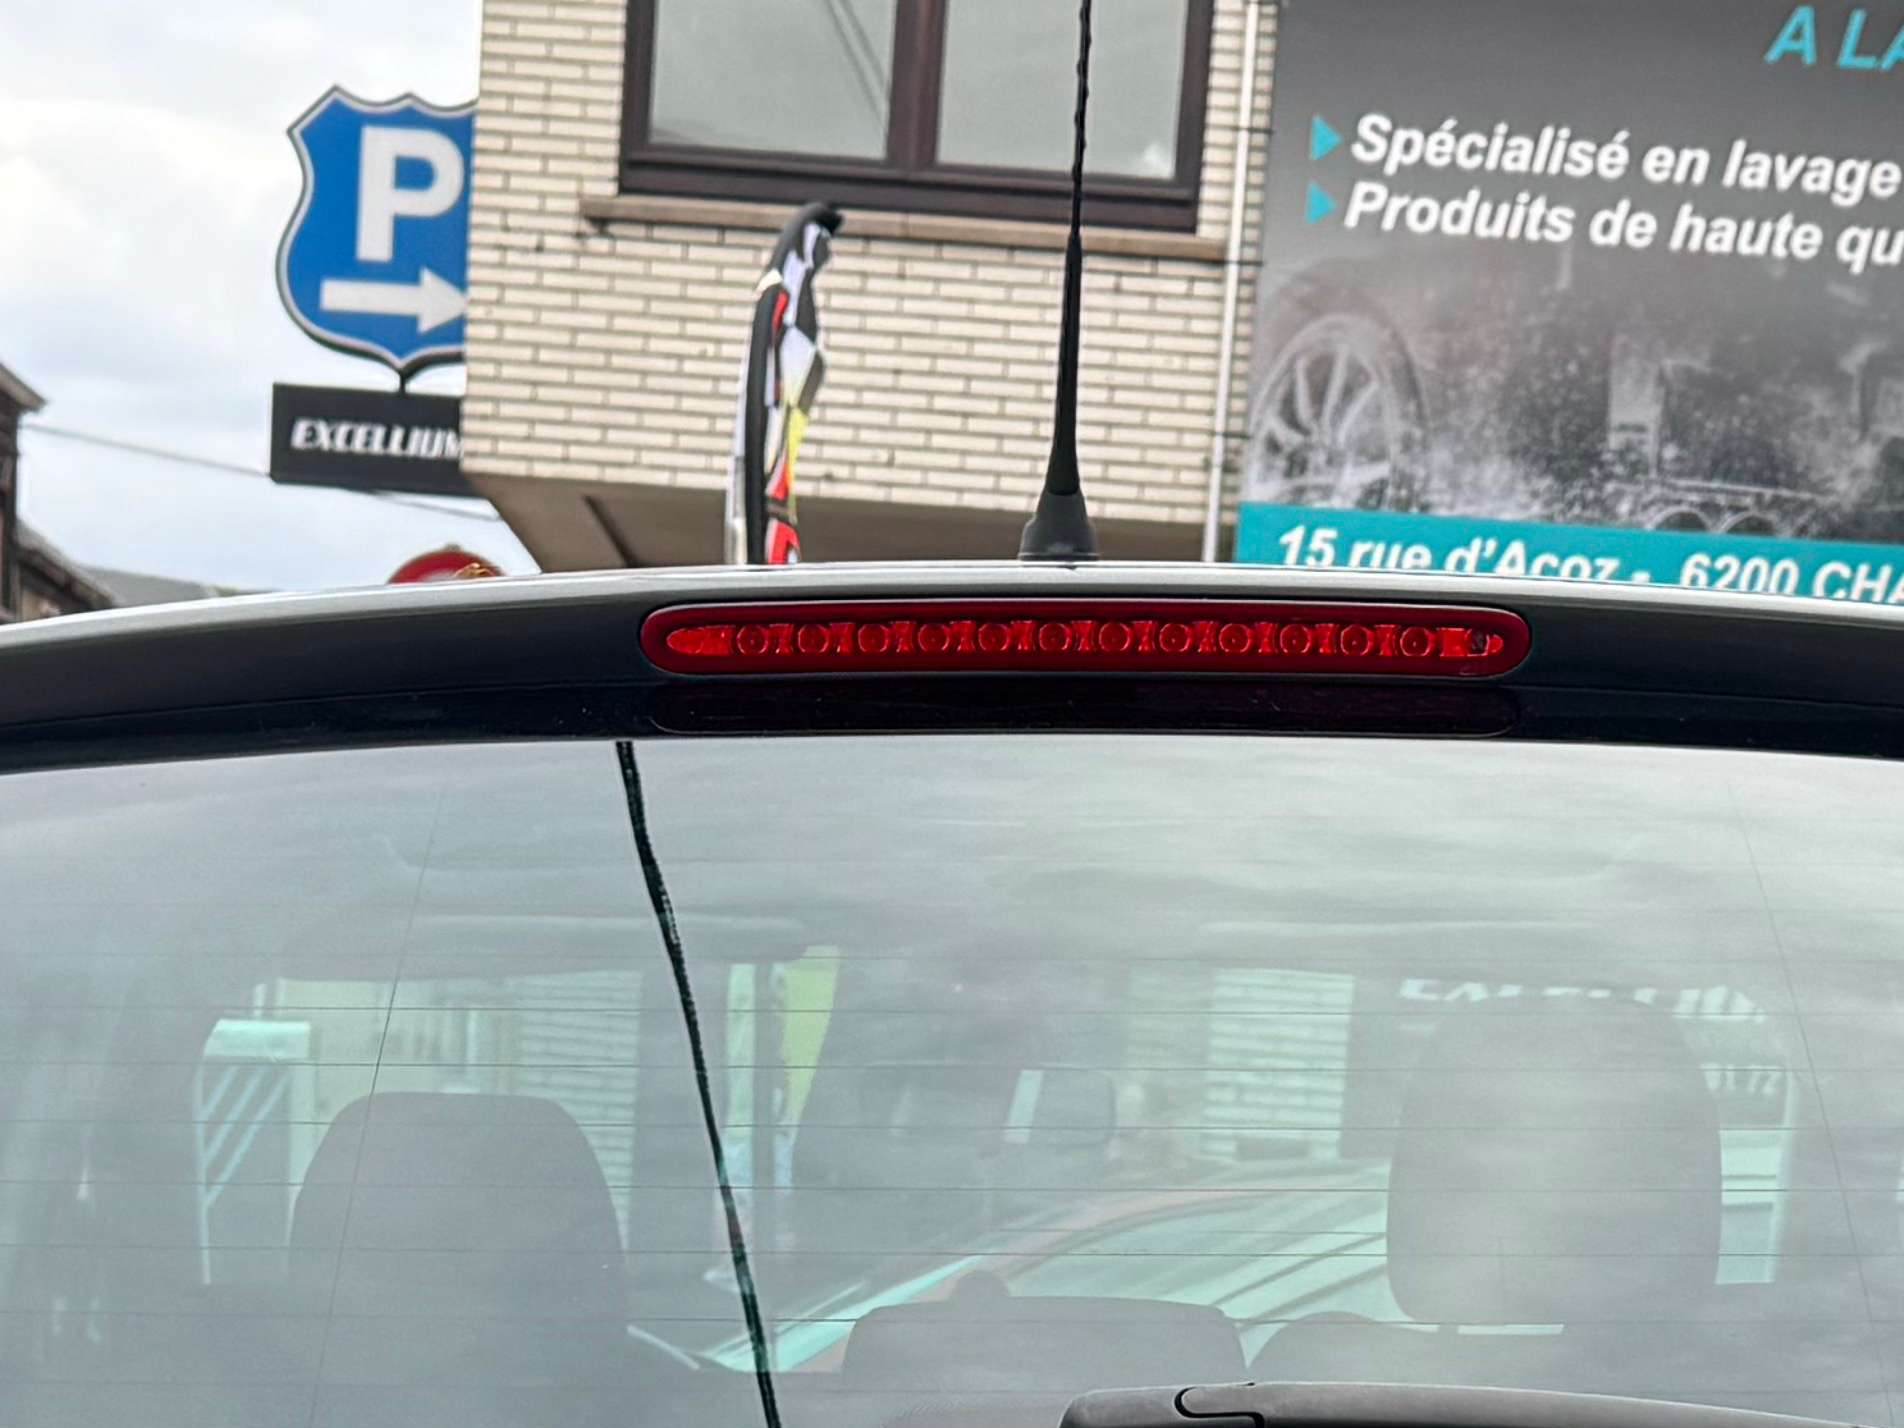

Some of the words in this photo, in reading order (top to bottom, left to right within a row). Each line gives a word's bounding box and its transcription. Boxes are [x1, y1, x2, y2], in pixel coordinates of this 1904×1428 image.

[1764, 4, 1817, 68] A
[1350, 112, 1631, 181] Spécialisé
[1642, 143, 1710, 187] en
[1722, 140, 1903, 207] lavage
[1343, 180, 1576, 244] Produits
[1588, 199, 1658, 250] de
[1668, 204, 1823, 260] haute
[1278, 524, 1338, 569] 15
[1347, 539, 1433, 571] rue
[1679, 552, 1799, 597] 6200
